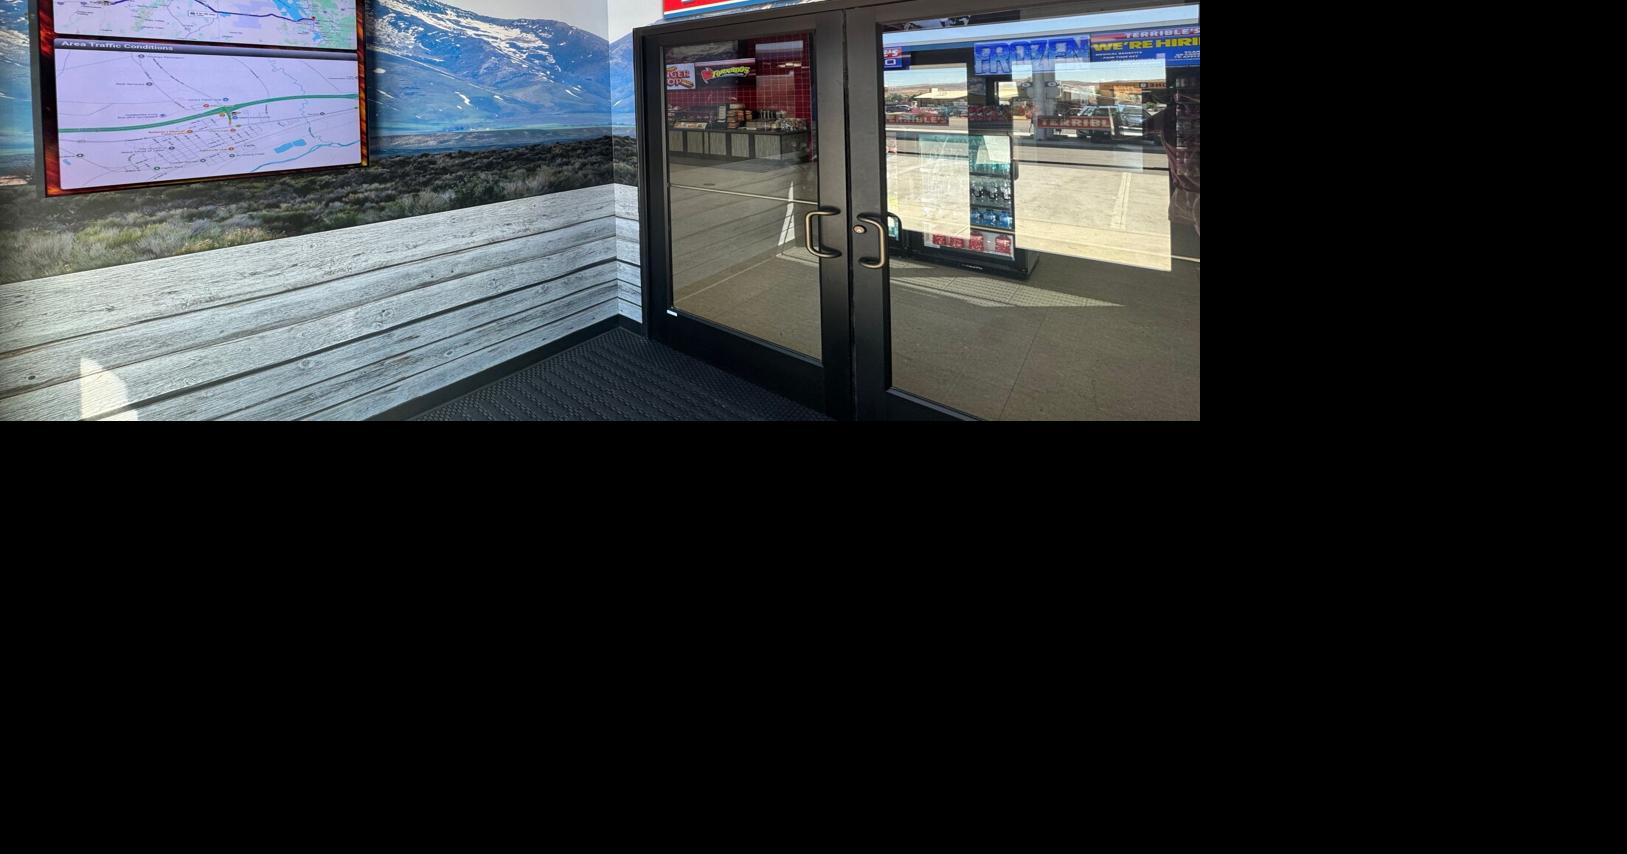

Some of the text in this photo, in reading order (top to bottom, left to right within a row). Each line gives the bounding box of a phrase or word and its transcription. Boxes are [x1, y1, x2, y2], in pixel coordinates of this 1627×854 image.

[124, 43, 174, 51] Conditions
[1092, 37, 1200, 51] WE'RE HIRI
[975, 38, 1090, 74] FROZEN
